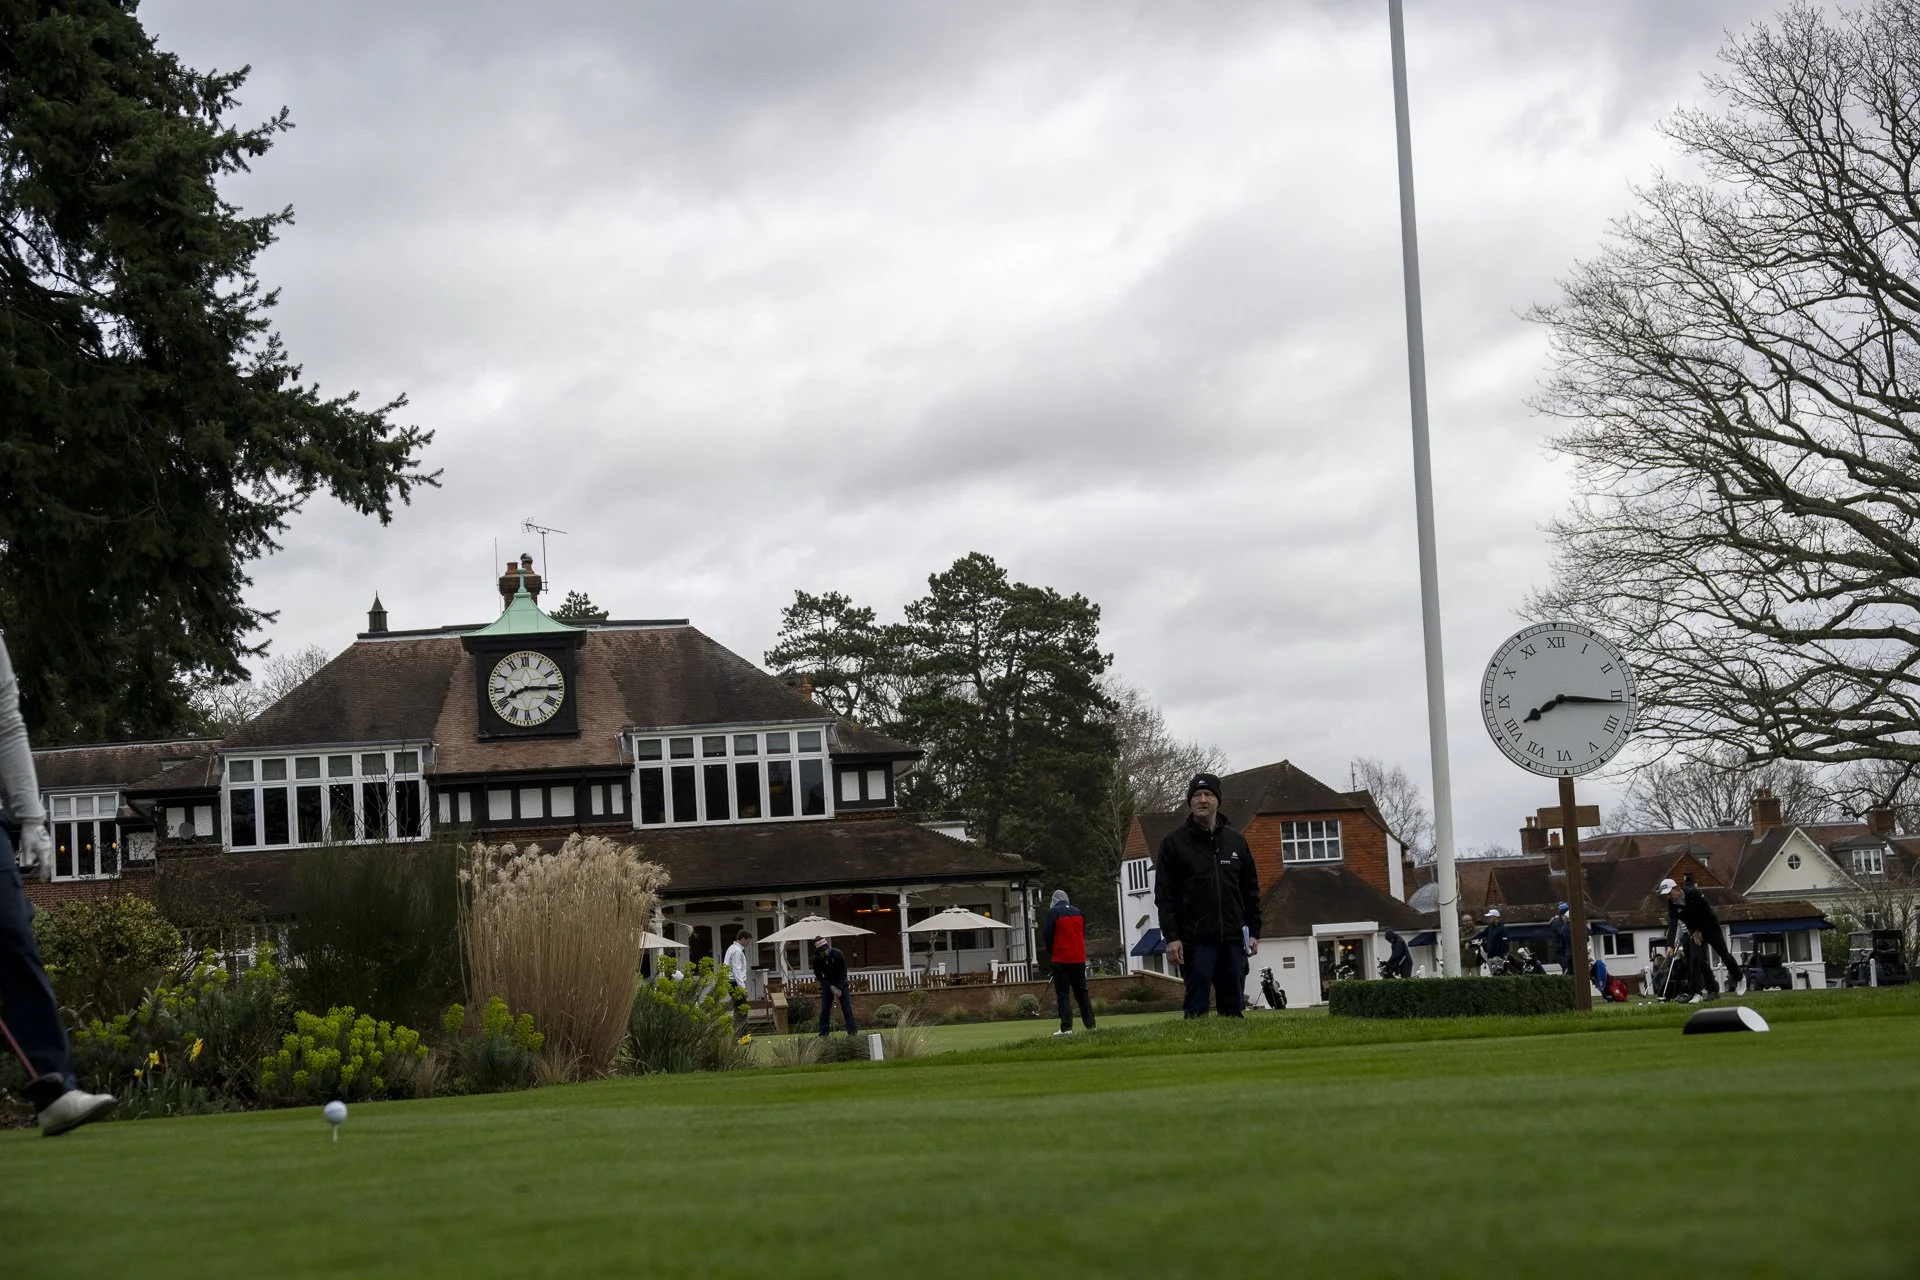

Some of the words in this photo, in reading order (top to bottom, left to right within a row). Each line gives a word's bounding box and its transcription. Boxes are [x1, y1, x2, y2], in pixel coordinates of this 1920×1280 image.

[1547, 637, 1566, 648] XII
[1581, 643, 1589, 654] I
[1520, 644, 1537, 660] XI
[1503, 667, 1516, 680] X
[1601, 662, 1614, 674] II
[1498, 694, 1510, 709] IX
[1610, 689, 1622, 702] II
[1504, 718, 1523, 743] VIII
[1603, 714, 1620, 734] IIII
[1526, 740, 1544, 759] VII
[1589, 741, 1599, 753] V
[1557, 750, 1573, 761] VI
